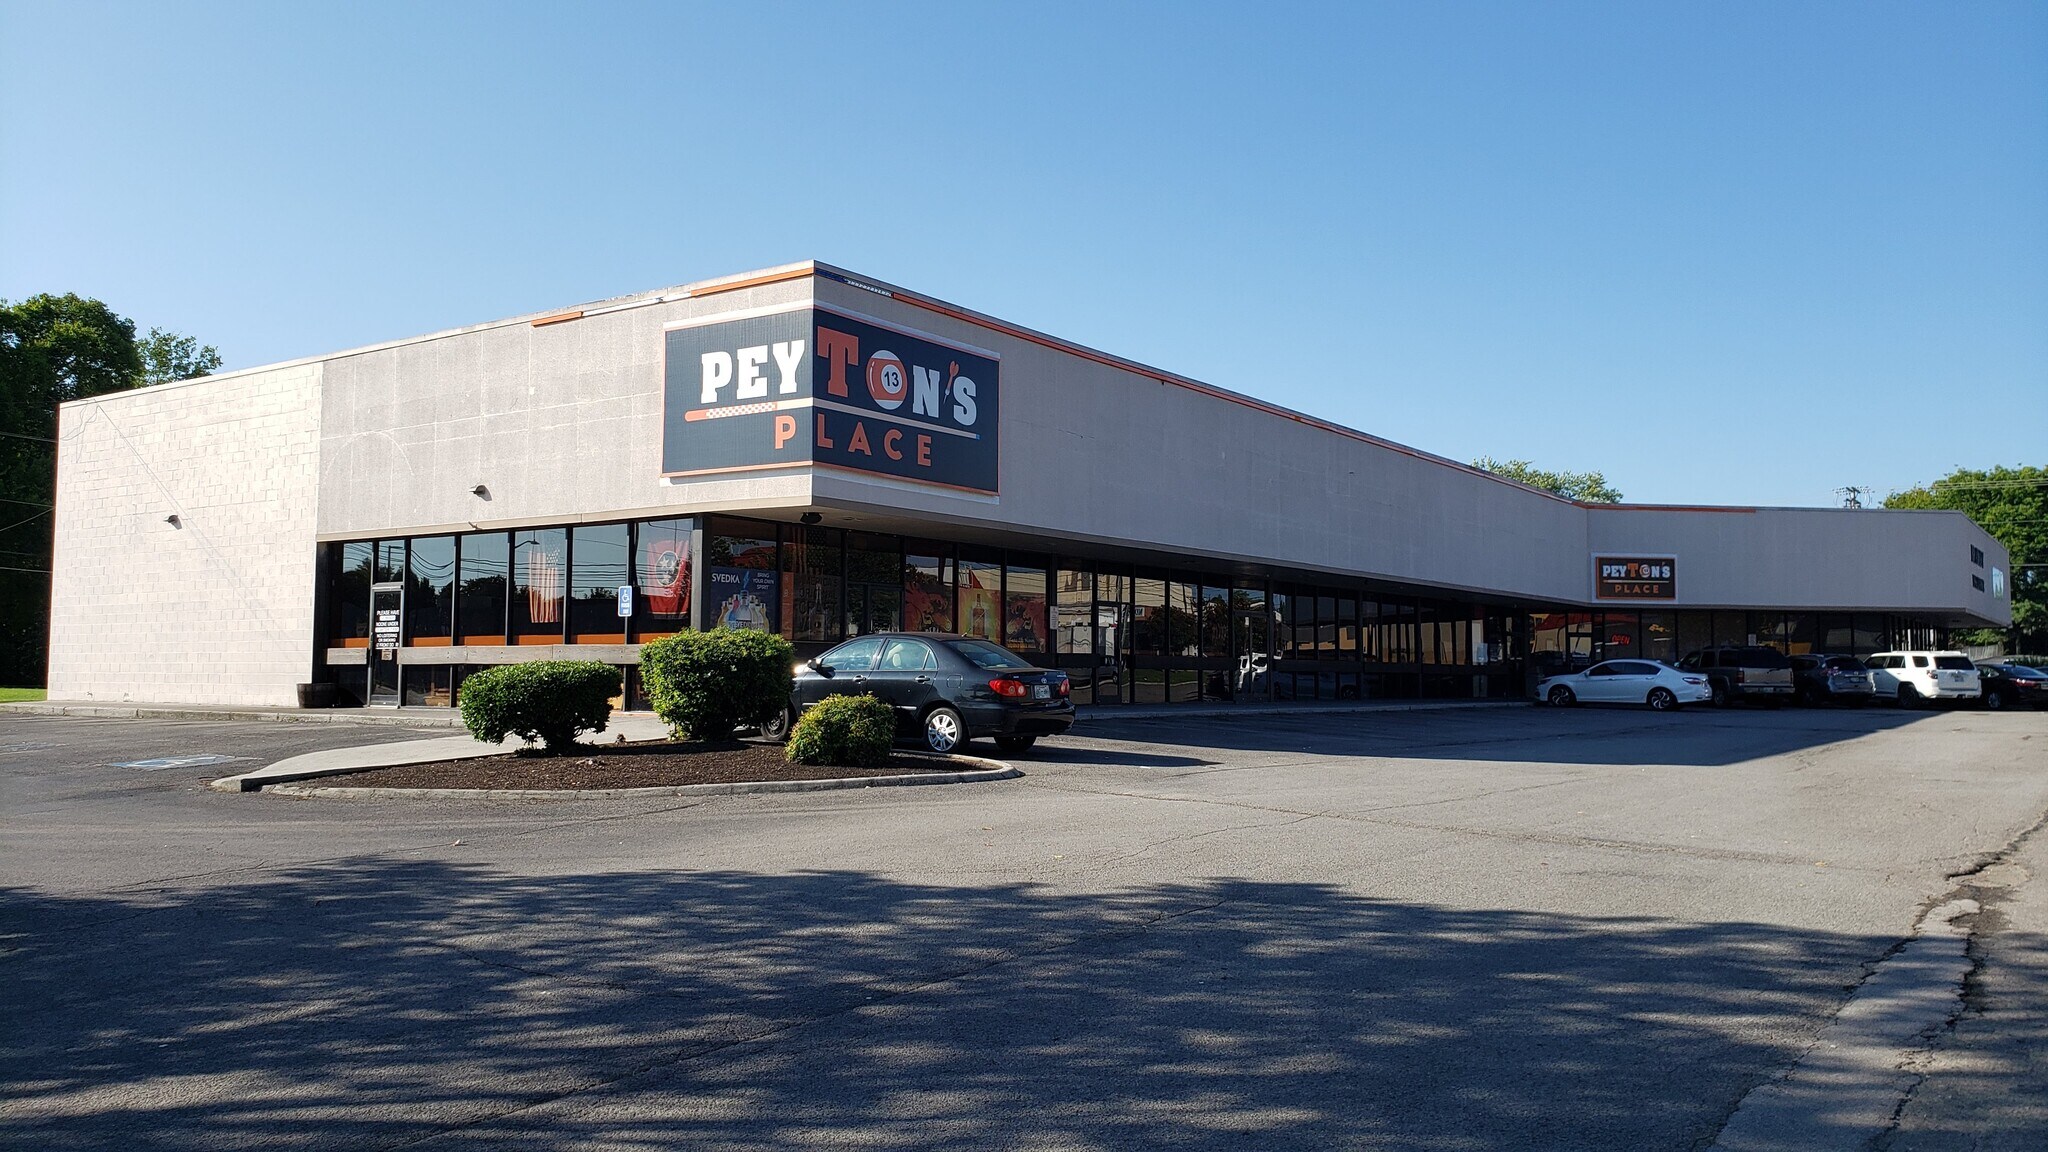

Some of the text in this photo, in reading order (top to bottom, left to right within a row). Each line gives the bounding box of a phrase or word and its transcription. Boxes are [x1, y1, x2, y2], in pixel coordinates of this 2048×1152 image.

[700, 325, 977, 426] PEYTON'S
[883, 371, 900, 388] 13
[774, 412, 932, 467] PLACE
[1602, 561, 1671, 578] PEYTON'S
[711, 573, 741, 584] SVEDKA
[1614, 584, 1660, 594] PLACE
[1611, 633, 1631, 645] OPEN
